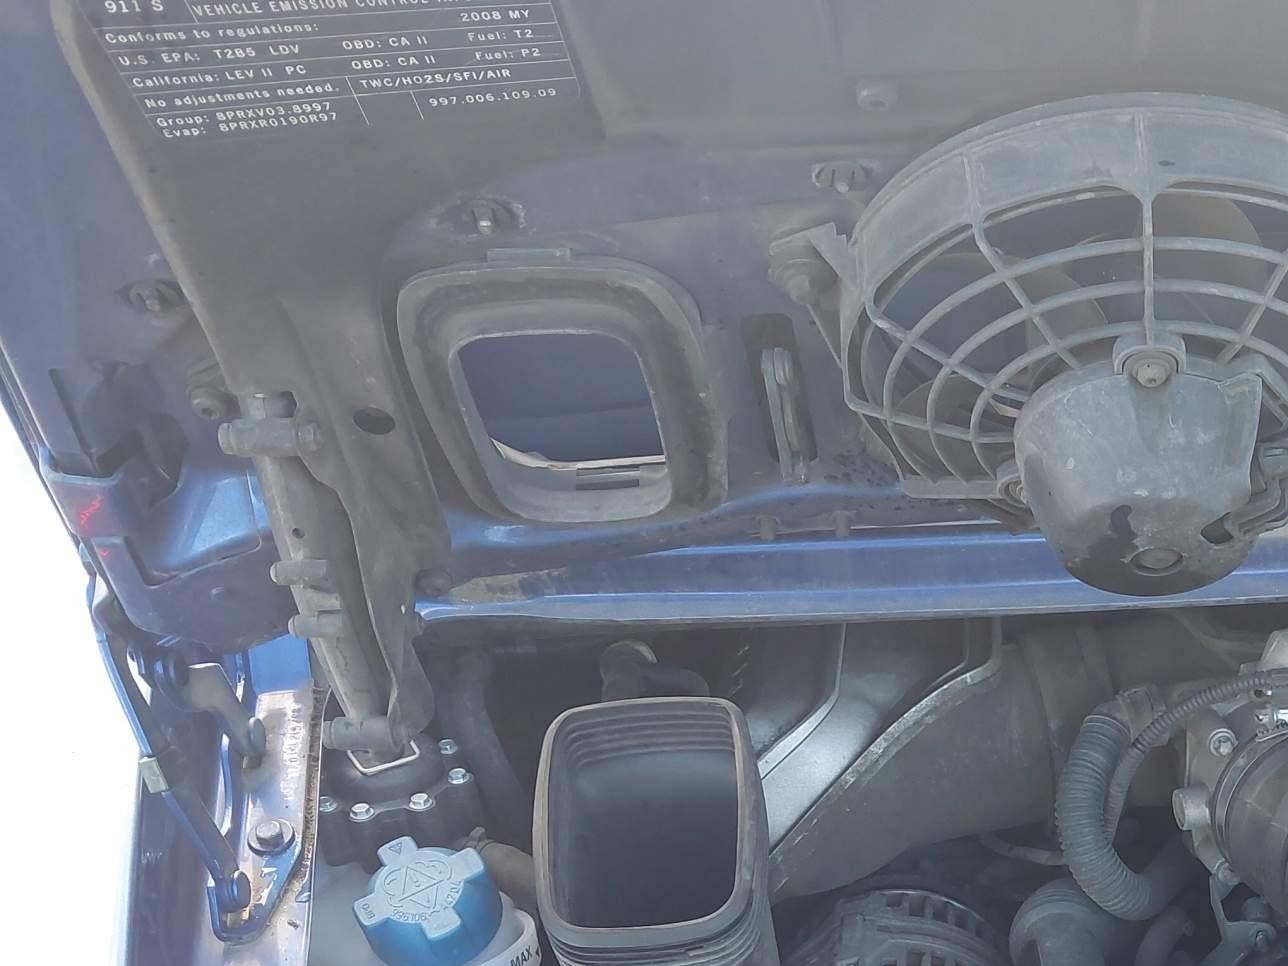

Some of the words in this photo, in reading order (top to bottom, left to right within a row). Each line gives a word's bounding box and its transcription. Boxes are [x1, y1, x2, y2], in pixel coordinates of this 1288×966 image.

[105, 1, 141, 14] 911
[152, 0, 164, 12] S
[192, 2, 263, 17] VEHICLE
[271, 0, 348, 12] EMISSION
[460, 11, 501, 22] 2008
[509, 9, 530, 19] MY
[105, 30, 186, 44] Conforms
[193, 29, 211, 39] to
[218, 22, 319, 38] regulations:
[467, 31, 507, 42] Fuel:
[513, 29, 534, 39] T2
[342, 39, 381, 50] OBD:
[388, 36, 411, 47] CA
[161, 52, 200, 64] EPA:
[269, 44, 300, 56] LDV
[474, 51, 514, 61] Fuel:
[521, 48, 541, 57] P2
[351, 58, 390, 70] OBD:
[397, 56, 420, 66] CA
[132, 72, 220, 88] California:
[225, 69, 254, 81] LEV
[285, 64, 306, 75] PC
[145, 98, 166, 109] No
[174, 90, 270, 107] adjustments
[277, 83, 340, 97] needed.
[429, 88, 556, 107] 997.006.109.09
[156, 114, 210, 129] Group:
[216, 102, 330, 122] 8PRXV03.8997
[163, 127, 207, 138] Evap:
